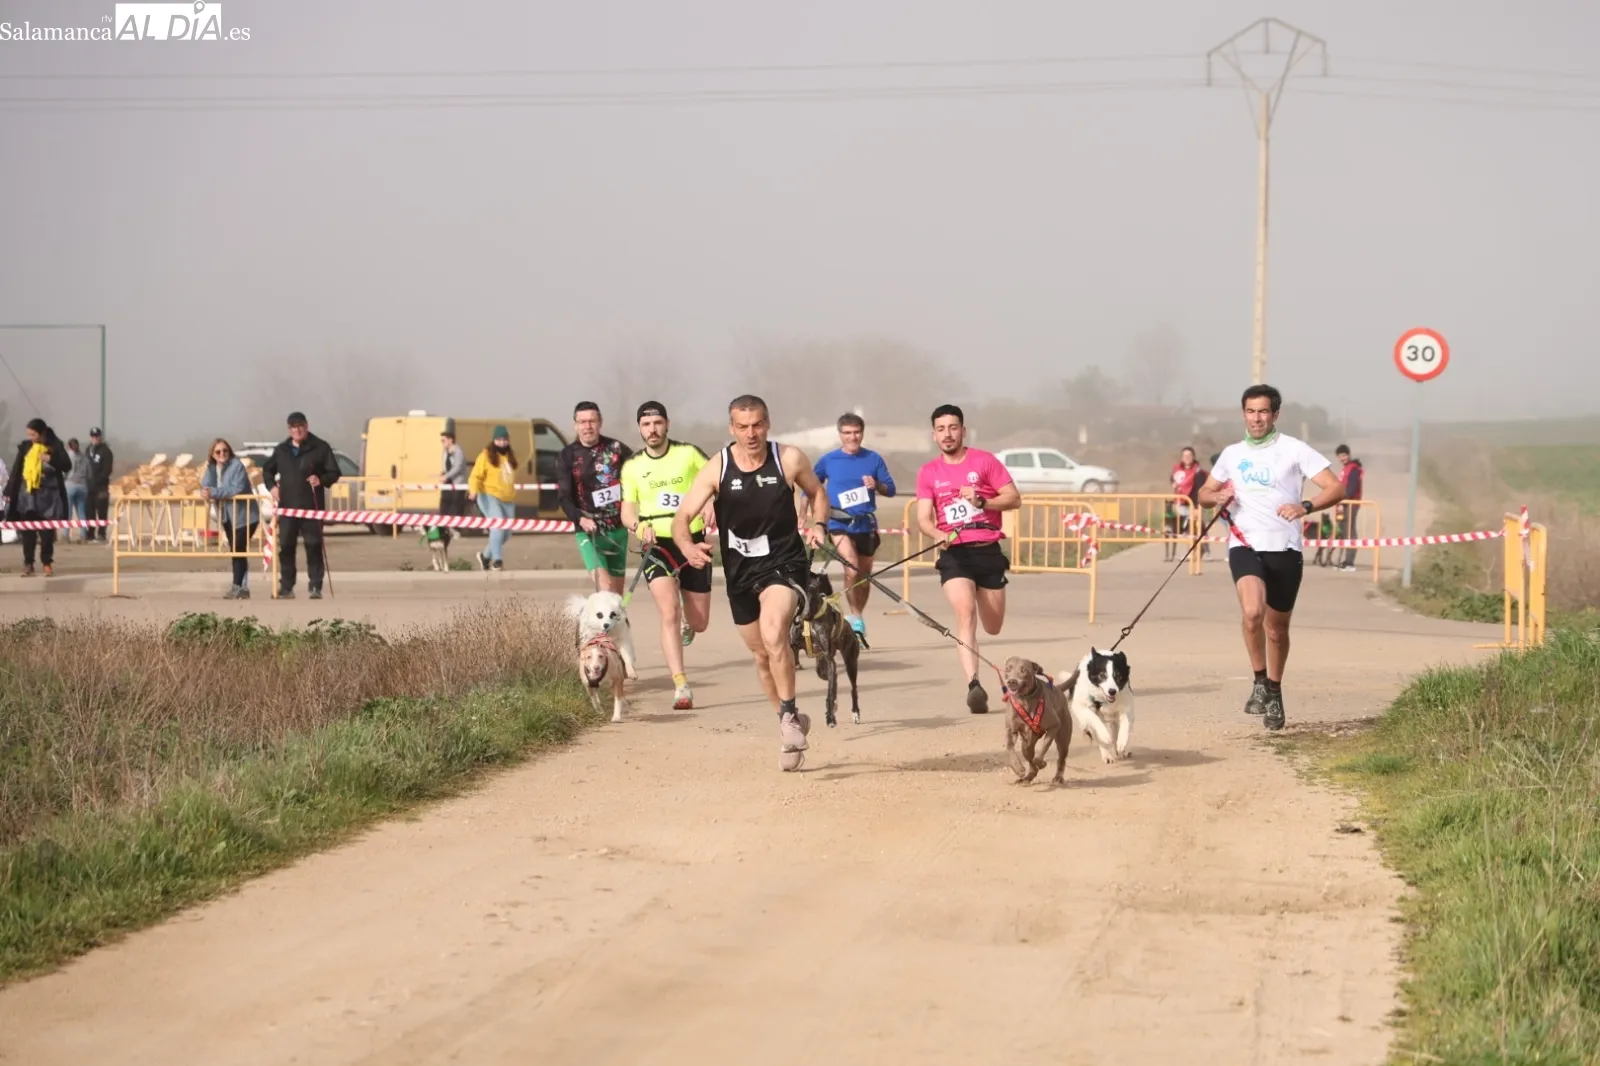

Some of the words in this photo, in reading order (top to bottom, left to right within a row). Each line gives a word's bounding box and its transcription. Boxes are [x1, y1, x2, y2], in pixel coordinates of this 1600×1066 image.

[1406, 345, 1435, 362] 30
[598, 490, 612, 504] 32
[662, 493, 680, 508] 33
[844, 491, 858, 504] 30
[949, 504, 968, 521] 29
